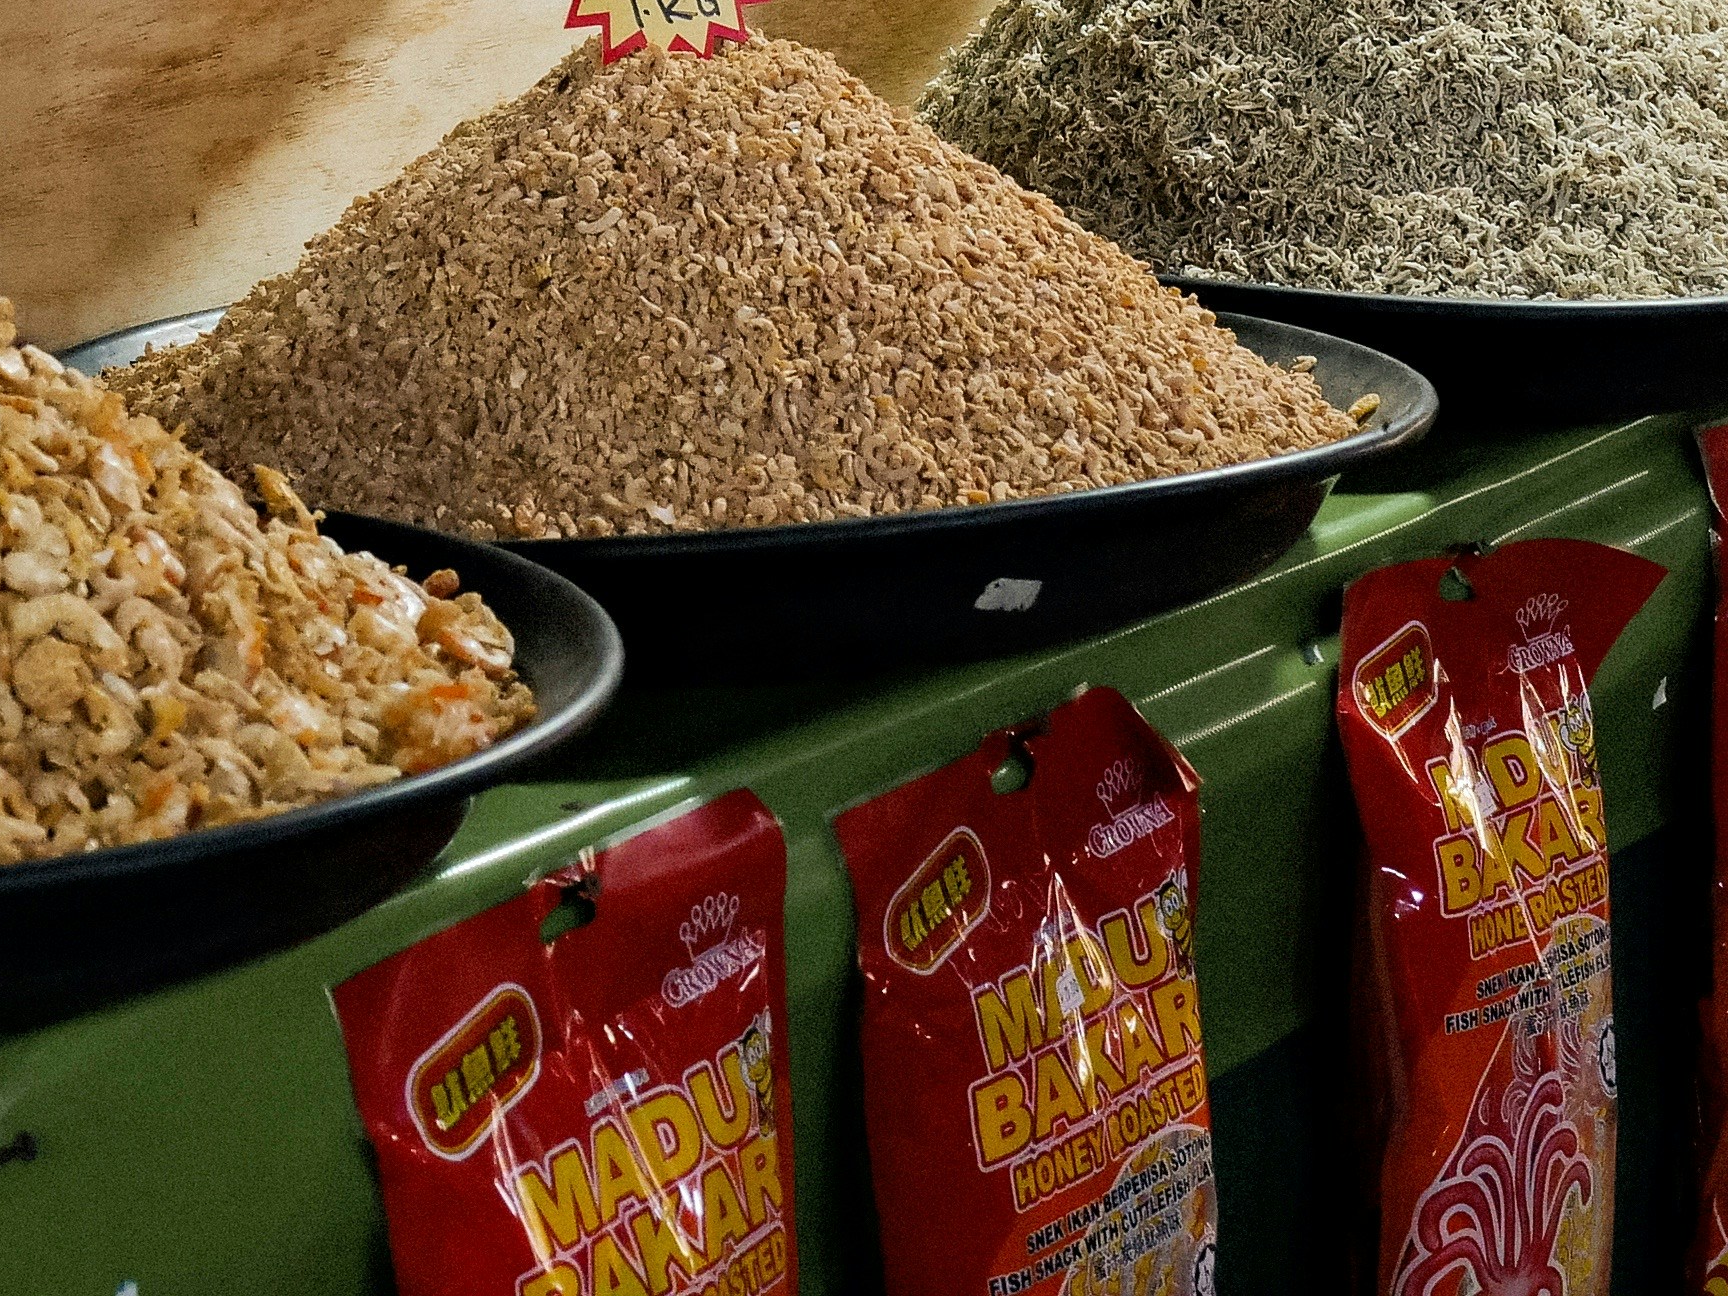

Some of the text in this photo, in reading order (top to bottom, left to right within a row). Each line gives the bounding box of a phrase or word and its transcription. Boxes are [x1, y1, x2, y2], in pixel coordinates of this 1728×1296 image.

[1088, 795, 1175, 859] CROWNA
[1439, 793, 1609, 913] BAKAR
[1445, 1009, 1479, 1036] FISH
[1519, 986, 1552, 1013] WITH
[974, 980, 1203, 1168] BAKAR
[517, 1048, 754, 1259] MADU
[1015, 1066, 1208, 1208] HONEY ROASTED
[989, 1264, 1034, 1296] FISH
[1034, 1239, 1084, 1277] SNACK
[1086, 1224, 1118, 1253] WITH
[1119, 1176, 1193, 1238] CUTTLEFISH
[1025, 1221, 1066, 1255] SNEK
[1067, 1209, 1102, 1241] IKAN
[1104, 1158, 1170, 1223] BERPERISA
